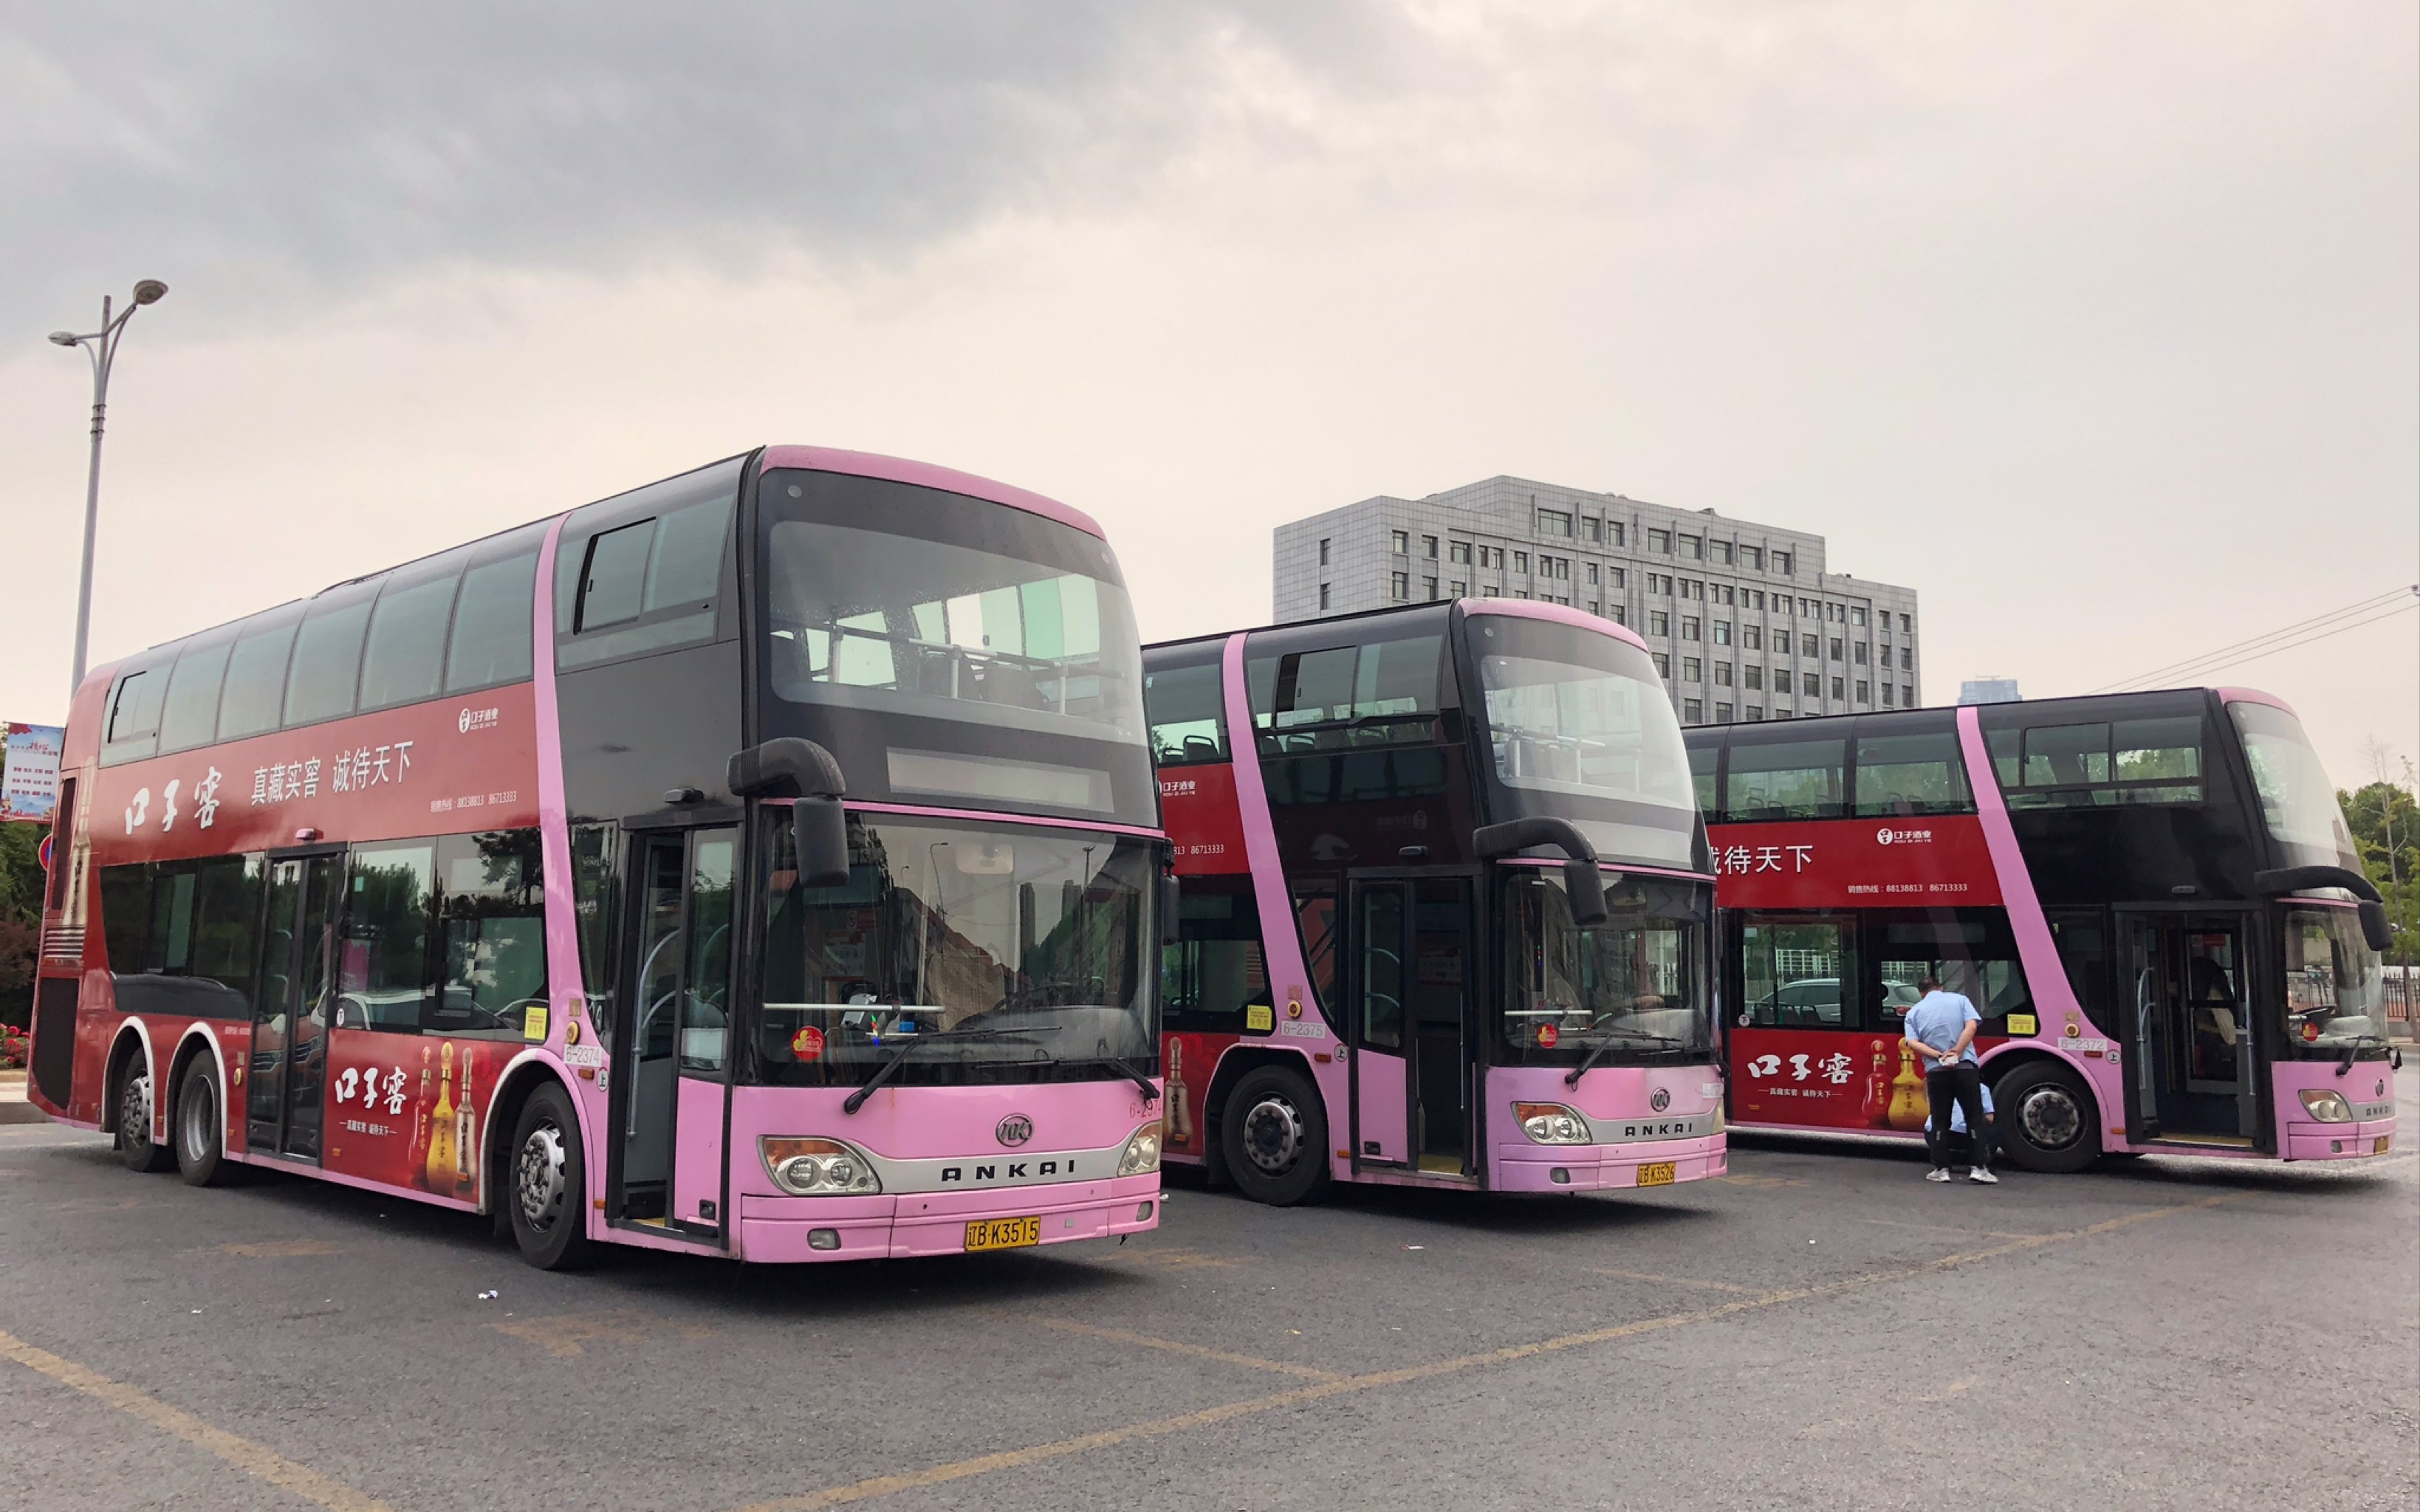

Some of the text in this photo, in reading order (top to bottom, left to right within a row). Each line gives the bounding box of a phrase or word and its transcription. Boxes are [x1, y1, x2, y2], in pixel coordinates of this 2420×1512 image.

[252, 740, 414, 806] 真藏实窖 诚待天下
[488, 790, 517, 805] 86713333
[1190, 844, 1225, 855] 86713333
[1885, 884, 1923, 893] 88138813
[1929, 883, 1968, 892] 86713333
[1283, 1023, 1323, 1037] 6-2375
[2061, 1039, 2104, 1050] 6-2372
[566, 1046, 600, 1063] 6-2374
[1747, 1052, 1854, 1085] 口子窖
[335, 1066, 408, 1116] 口子窖
[1625, 1122, 1693, 1137] ANKAI
[941, 1159, 1075, 1182] ANKAI
